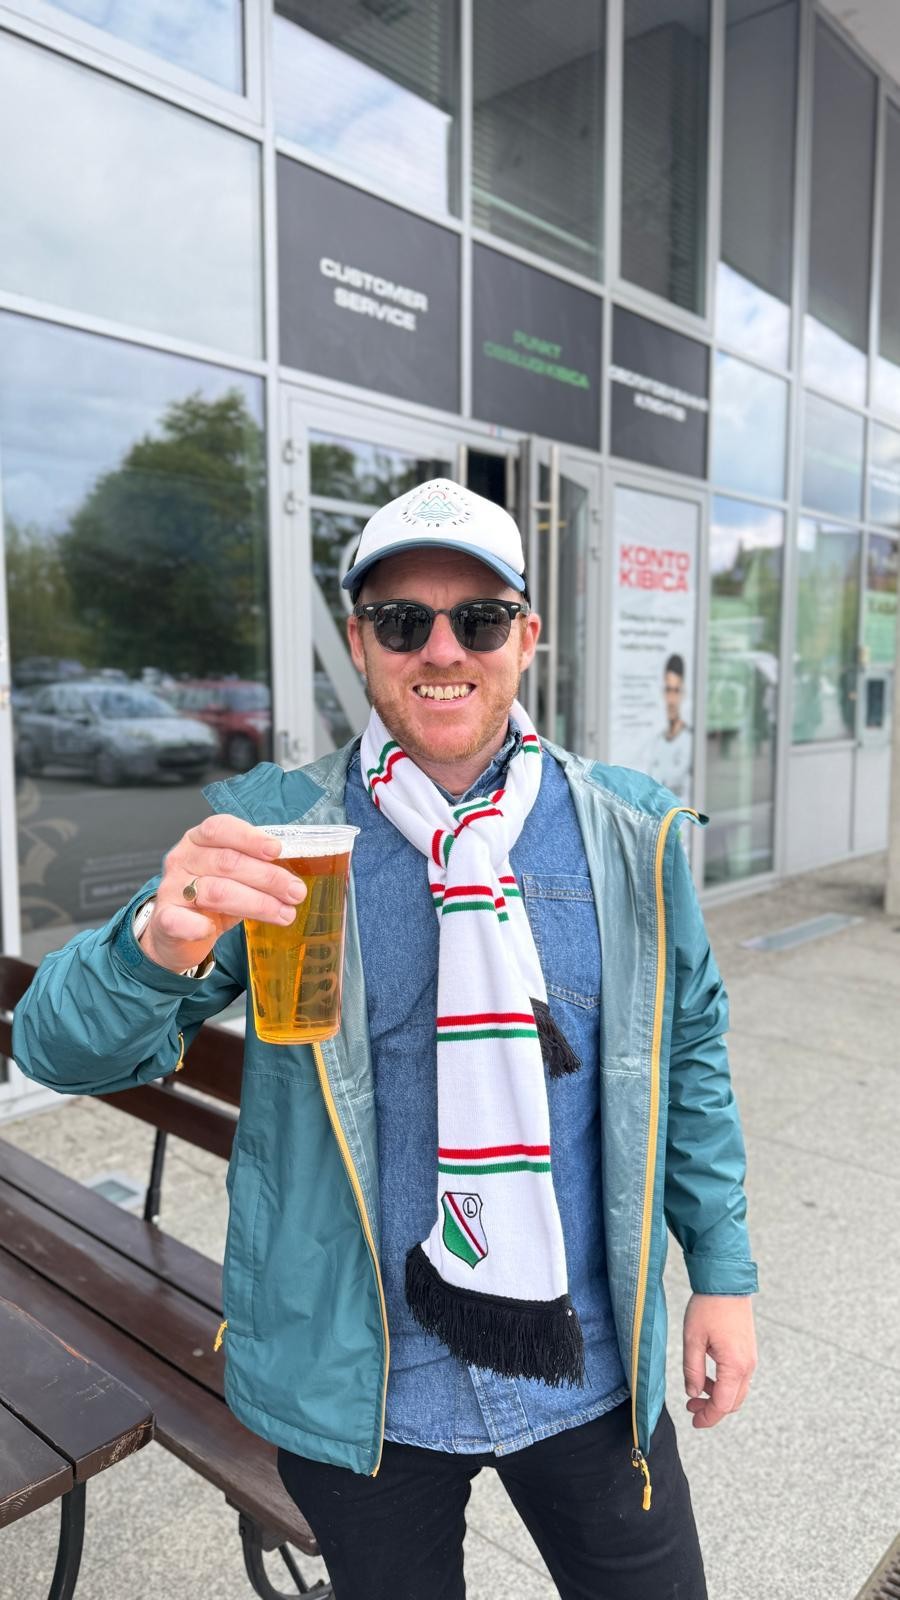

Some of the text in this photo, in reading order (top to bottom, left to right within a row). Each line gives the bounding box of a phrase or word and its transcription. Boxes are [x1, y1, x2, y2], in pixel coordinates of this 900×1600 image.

[320, 257, 428, 312] CUSTOMER
[334, 286, 416, 331] SERVICE
[513, 329, 562, 358] PUNKT
[620, 544, 689, 573] KONTO
[620, 566, 689, 592] KIBICA
[466, 1201, 474, 1215] L
